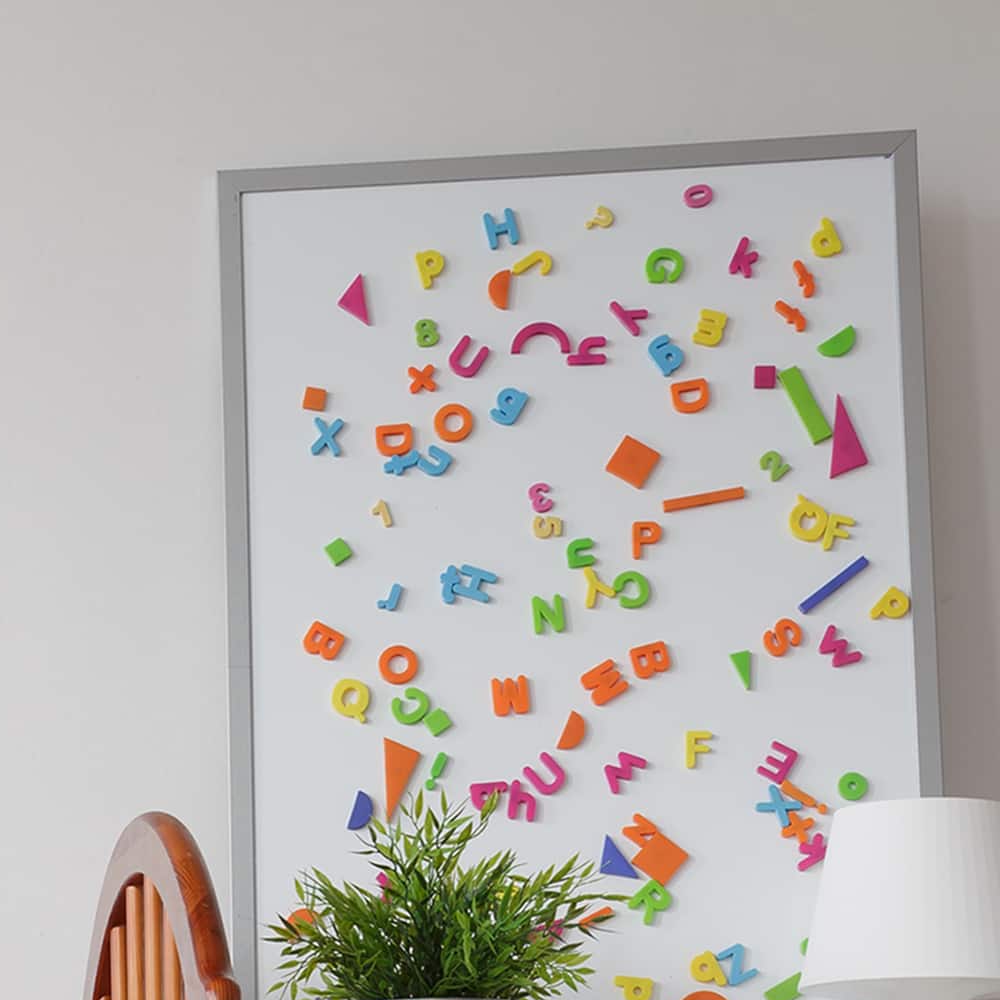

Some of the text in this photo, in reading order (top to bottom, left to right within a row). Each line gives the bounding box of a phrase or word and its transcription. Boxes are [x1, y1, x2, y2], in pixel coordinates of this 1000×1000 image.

[482, 207, 520, 250] H
[760, 450, 792, 482] 2
[631, 520, 663, 560] P
[452, 564, 498, 603] H
[531, 594, 566, 635] N
[303, 620, 345, 661] B
[630, 641, 671, 680] B
[331, 678, 370, 724] Q
[686, 730, 712, 769] F
